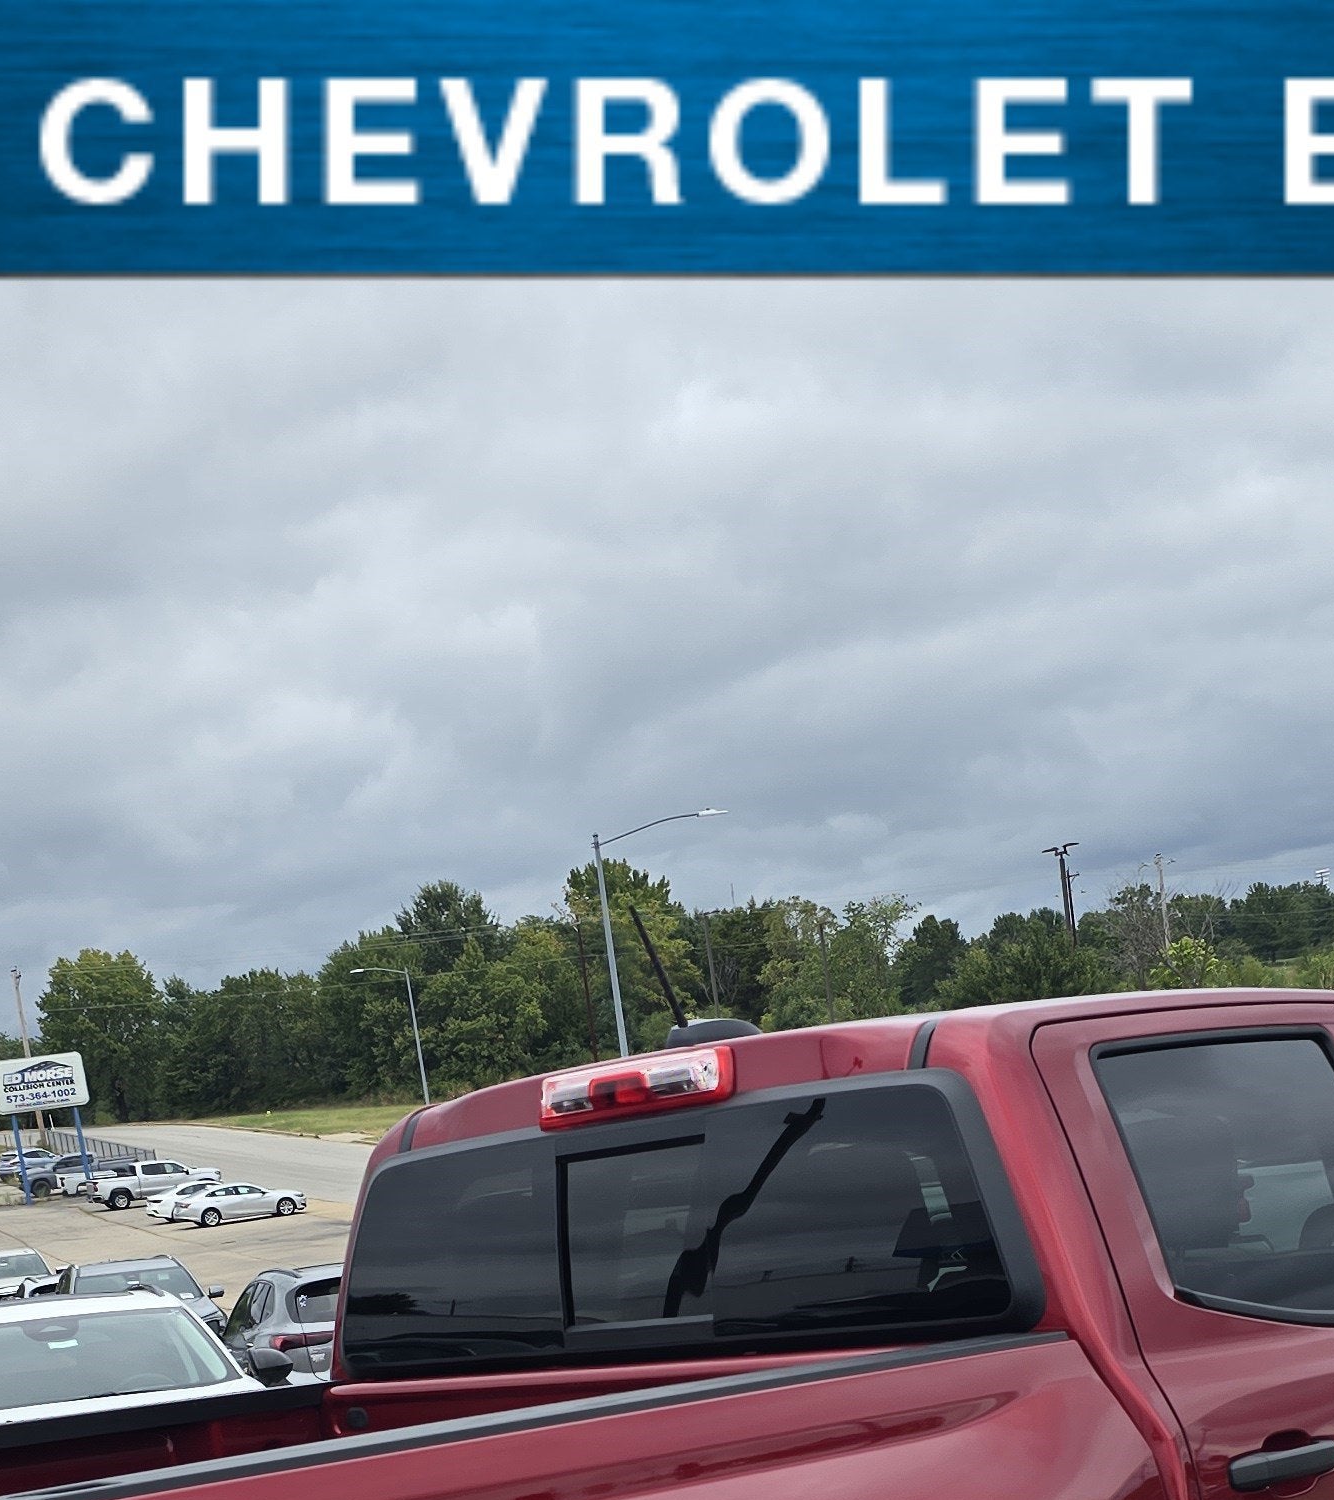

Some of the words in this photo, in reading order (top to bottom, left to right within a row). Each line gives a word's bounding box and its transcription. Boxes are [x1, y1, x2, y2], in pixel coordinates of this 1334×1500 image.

[3, 1073, 22, 1086] ED
[24, 1065, 73, 1083] MORSE
[3, 1082, 45, 1093] COLLISION
[46, 1079, 75, 1088] CENTER
[6, 1087, 77, 1104] 573-364-1002
